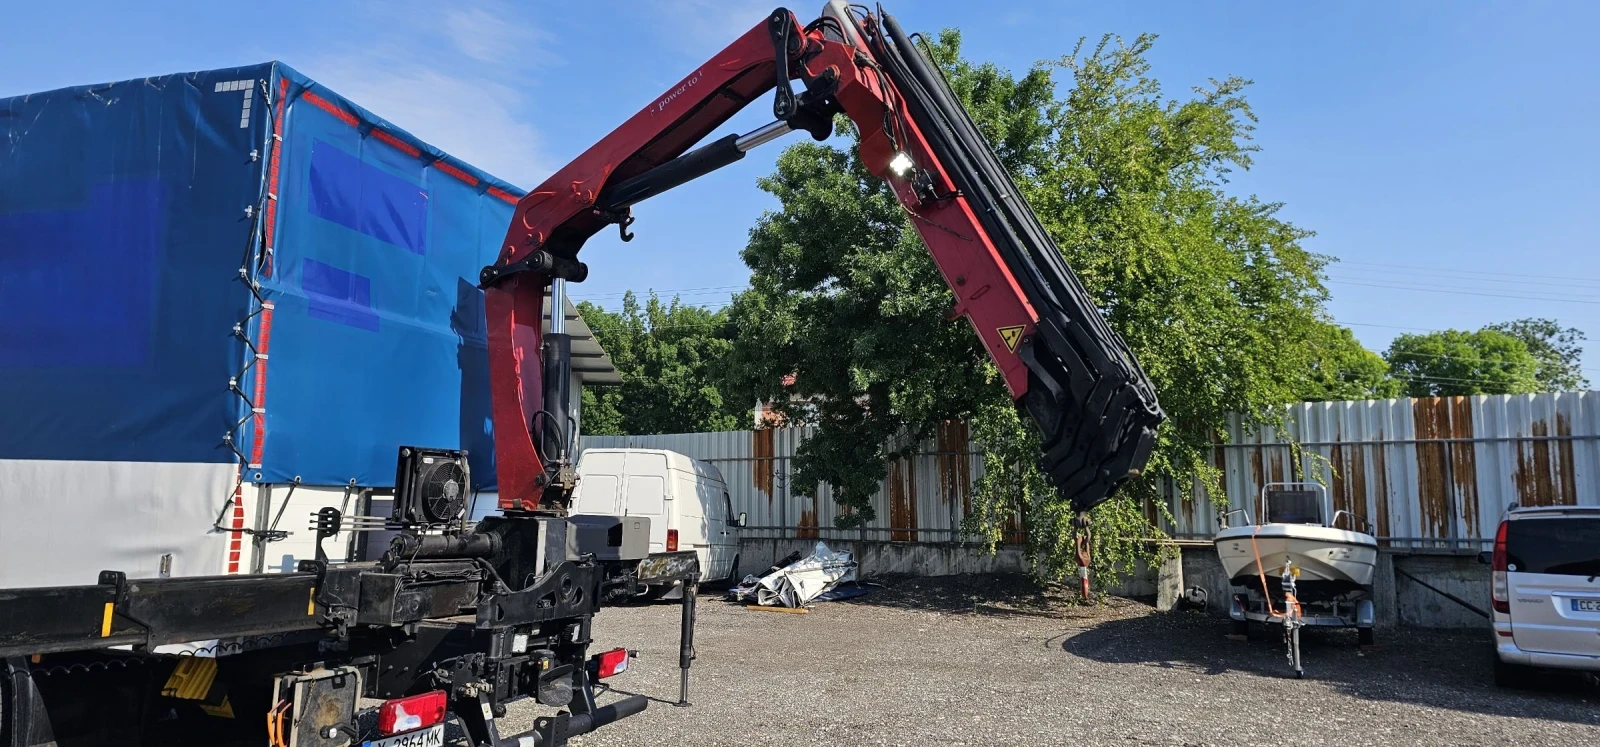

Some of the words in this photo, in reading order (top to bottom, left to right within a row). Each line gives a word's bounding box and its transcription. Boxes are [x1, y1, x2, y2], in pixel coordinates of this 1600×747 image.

[658, 84, 686, 111] power
[687, 76, 698, 87] to
[426, 728, 441, 747] MK
